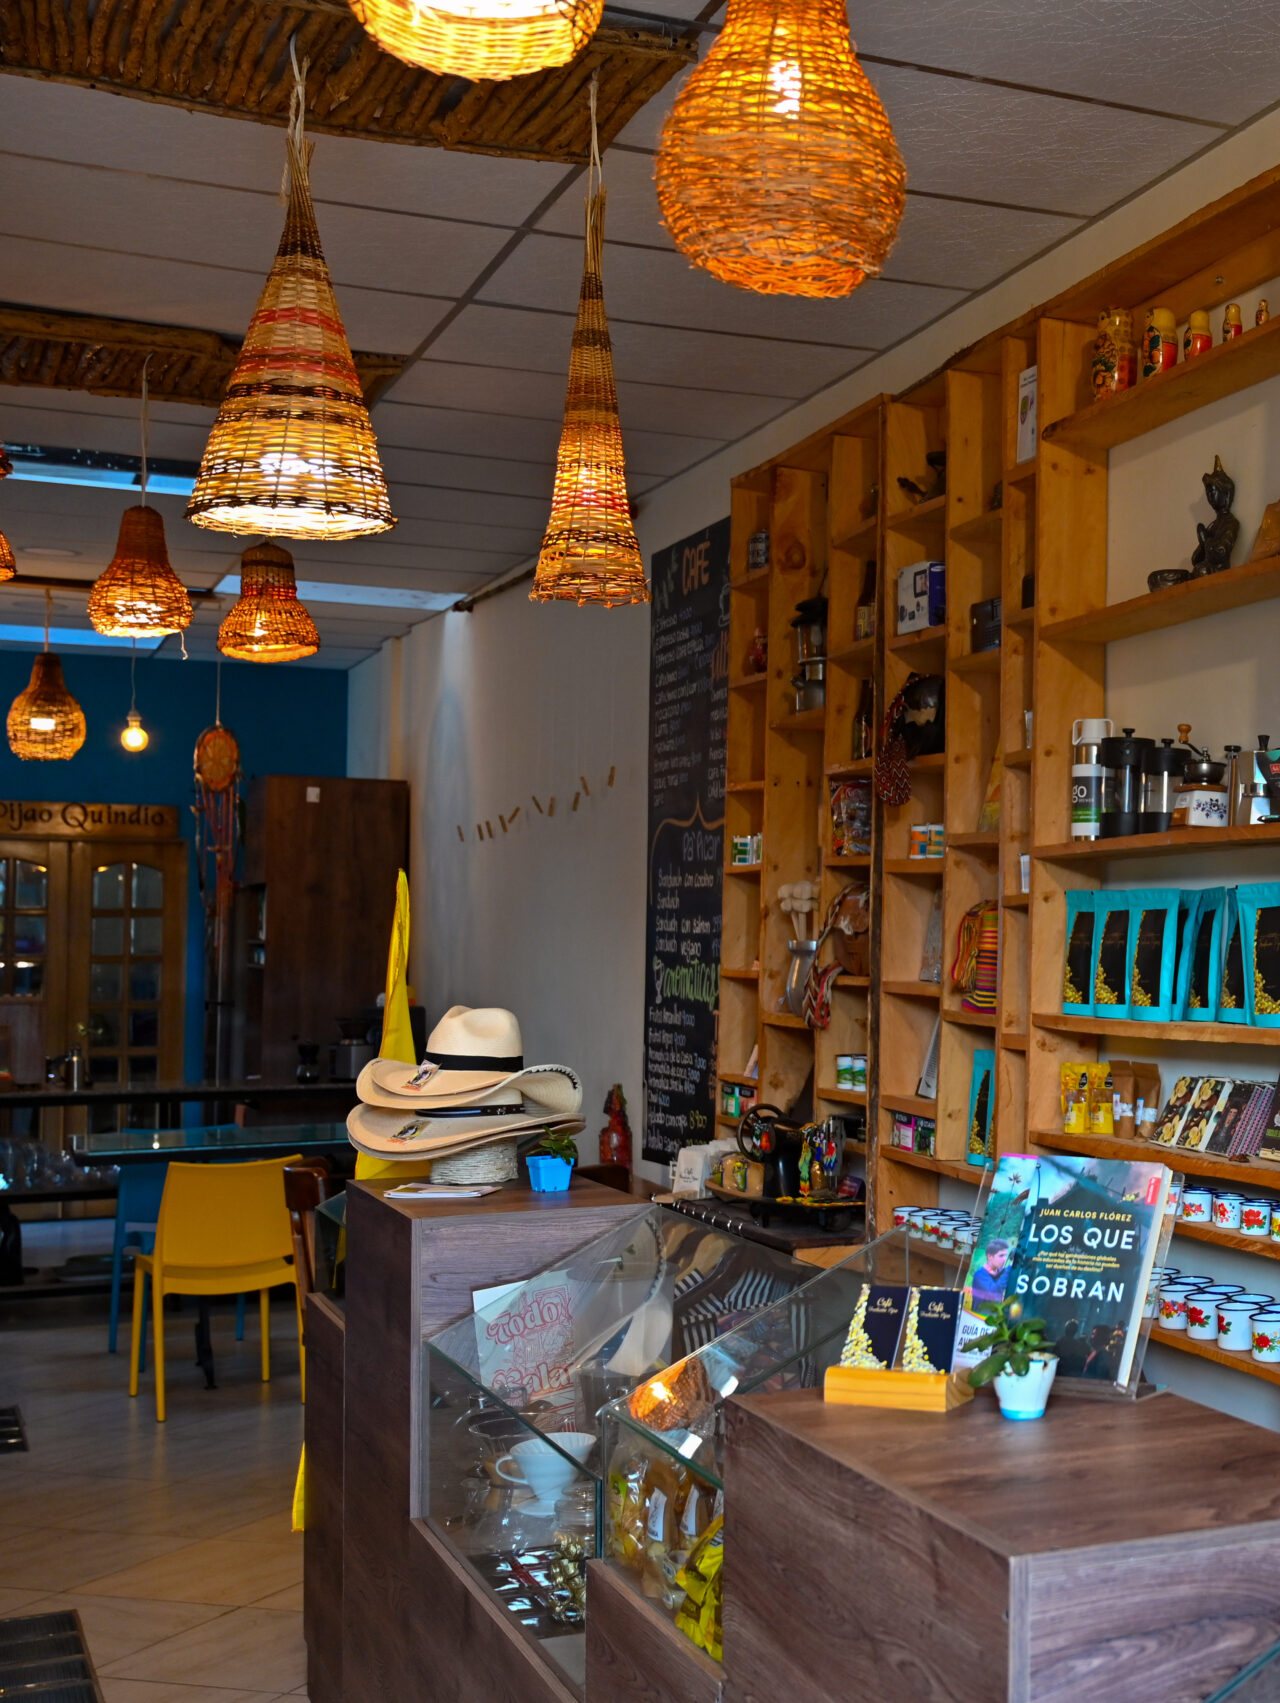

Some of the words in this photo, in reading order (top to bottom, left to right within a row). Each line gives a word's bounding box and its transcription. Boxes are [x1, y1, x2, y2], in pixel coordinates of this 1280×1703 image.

[61, 802, 164, 832] Quindio
[1040, 1208, 1061, 1218] JUAN
[1063, 1209, 1097, 1220] CARLOS
[1099, 1211, 1132, 1223] FLÓREZ
[1028, 1223, 1073, 1245] LOS
[1083, 1227, 1136, 1250] QUE
[1015, 1274, 1125, 1303] SOBRAN
[876, 1297, 893, 1308] Café
[928, 1302, 944, 1312] Café
[487, 1299, 561, 1345] Todo
[962, 1325, 979, 1337] GUÍA
